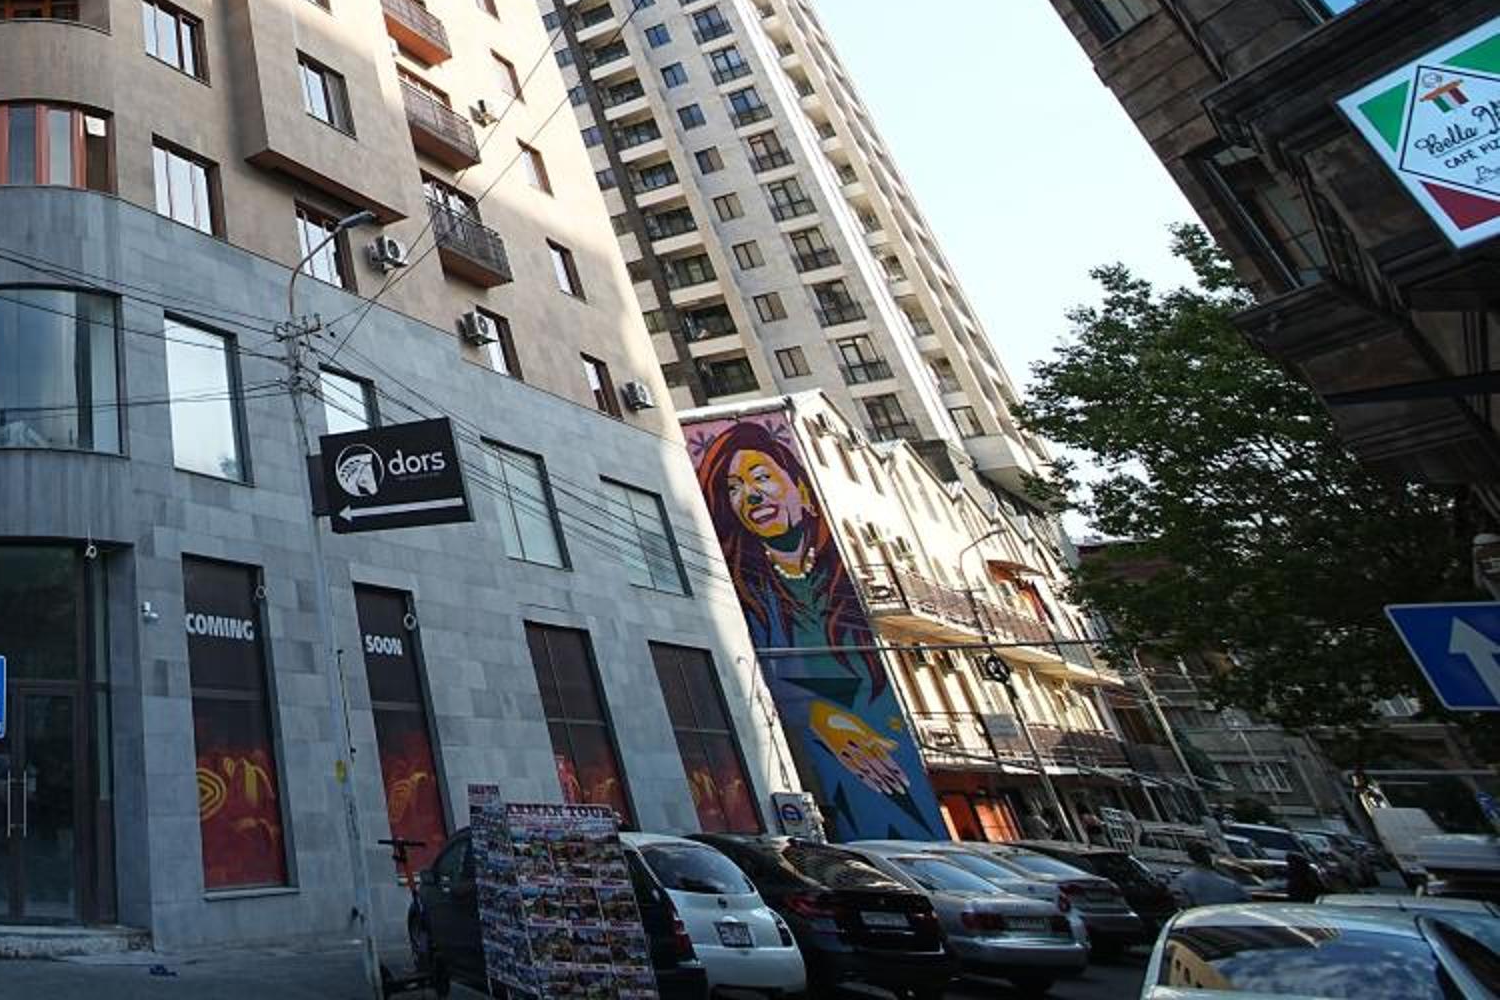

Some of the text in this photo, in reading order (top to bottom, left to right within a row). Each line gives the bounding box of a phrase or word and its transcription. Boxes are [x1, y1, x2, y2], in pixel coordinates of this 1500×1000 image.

[1414, 123, 1477, 155] Bella
[1444, 149, 1477, 168] CAFE
[388, 449, 445, 475] dors
[185, 613, 254, 641] COMING
[365, 634, 403, 656] SOON
